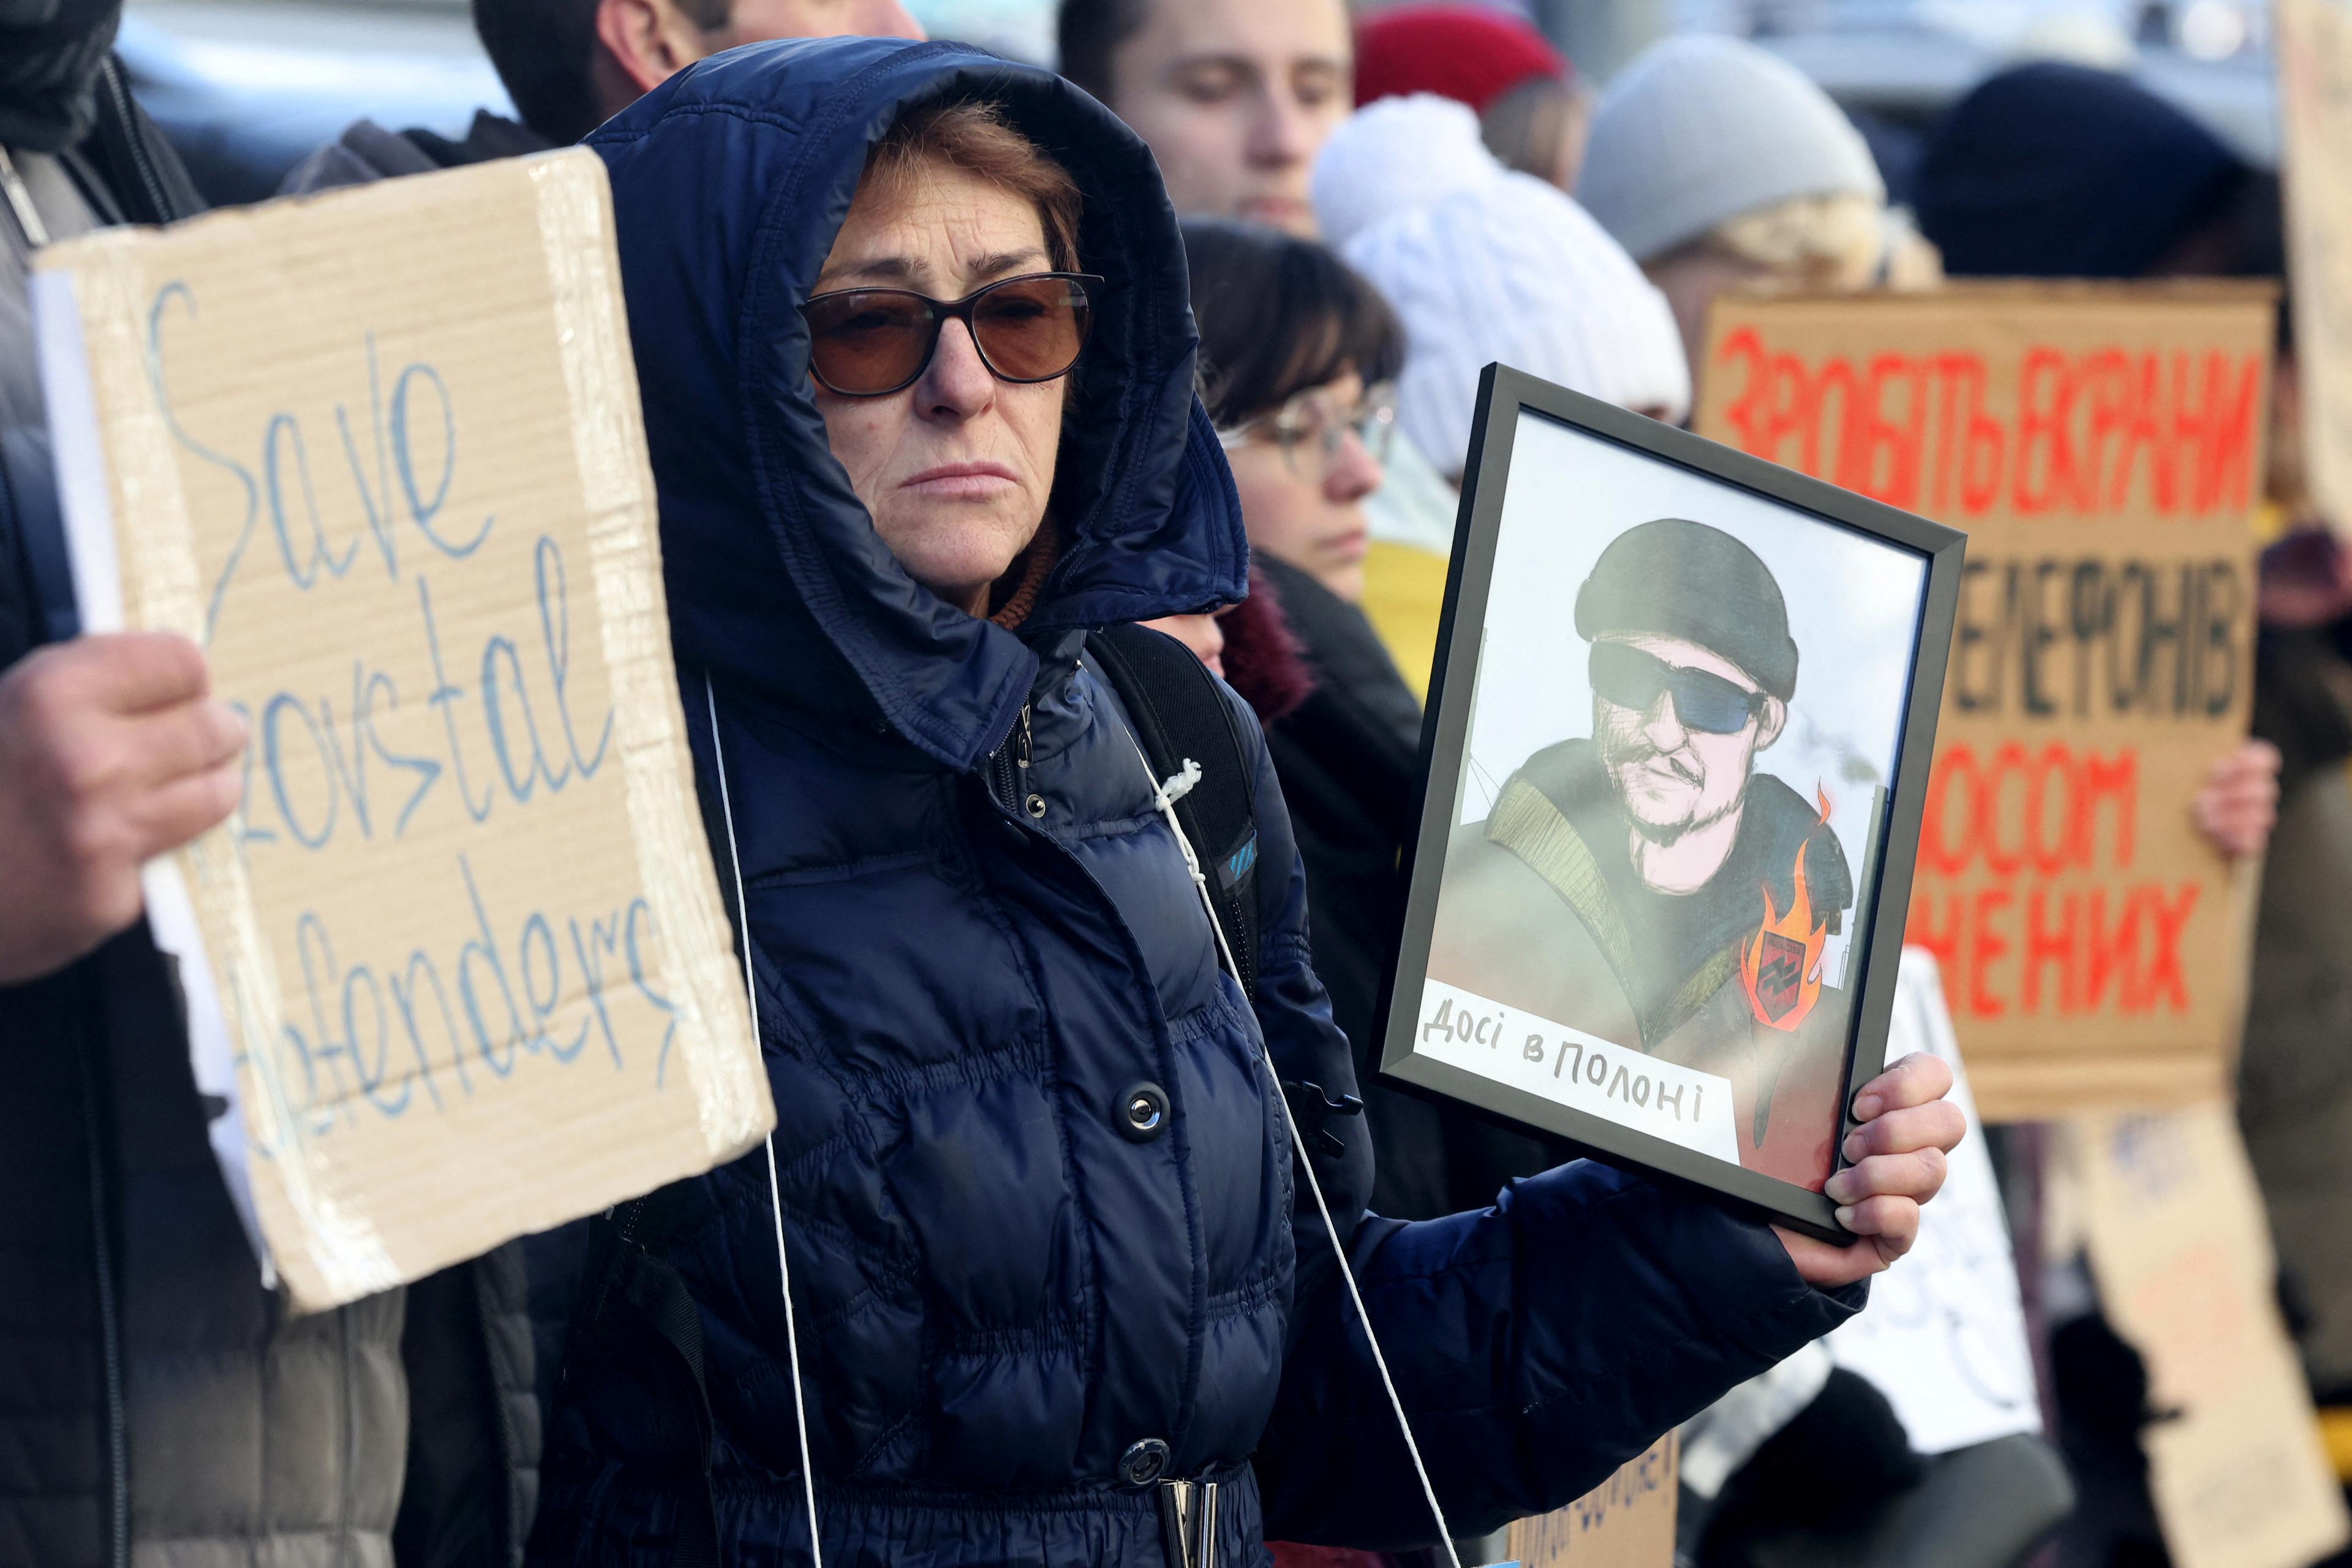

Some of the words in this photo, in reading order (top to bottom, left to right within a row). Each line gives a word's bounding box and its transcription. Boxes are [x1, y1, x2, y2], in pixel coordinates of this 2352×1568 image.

[147, 279, 495, 657] Save
[1955, 556, 2237, 718] ЕЛЕФОНІВ
[1918, 737, 2139, 880] ОСОМ
[1902, 881, 2203, 1021] НЕНИХ
